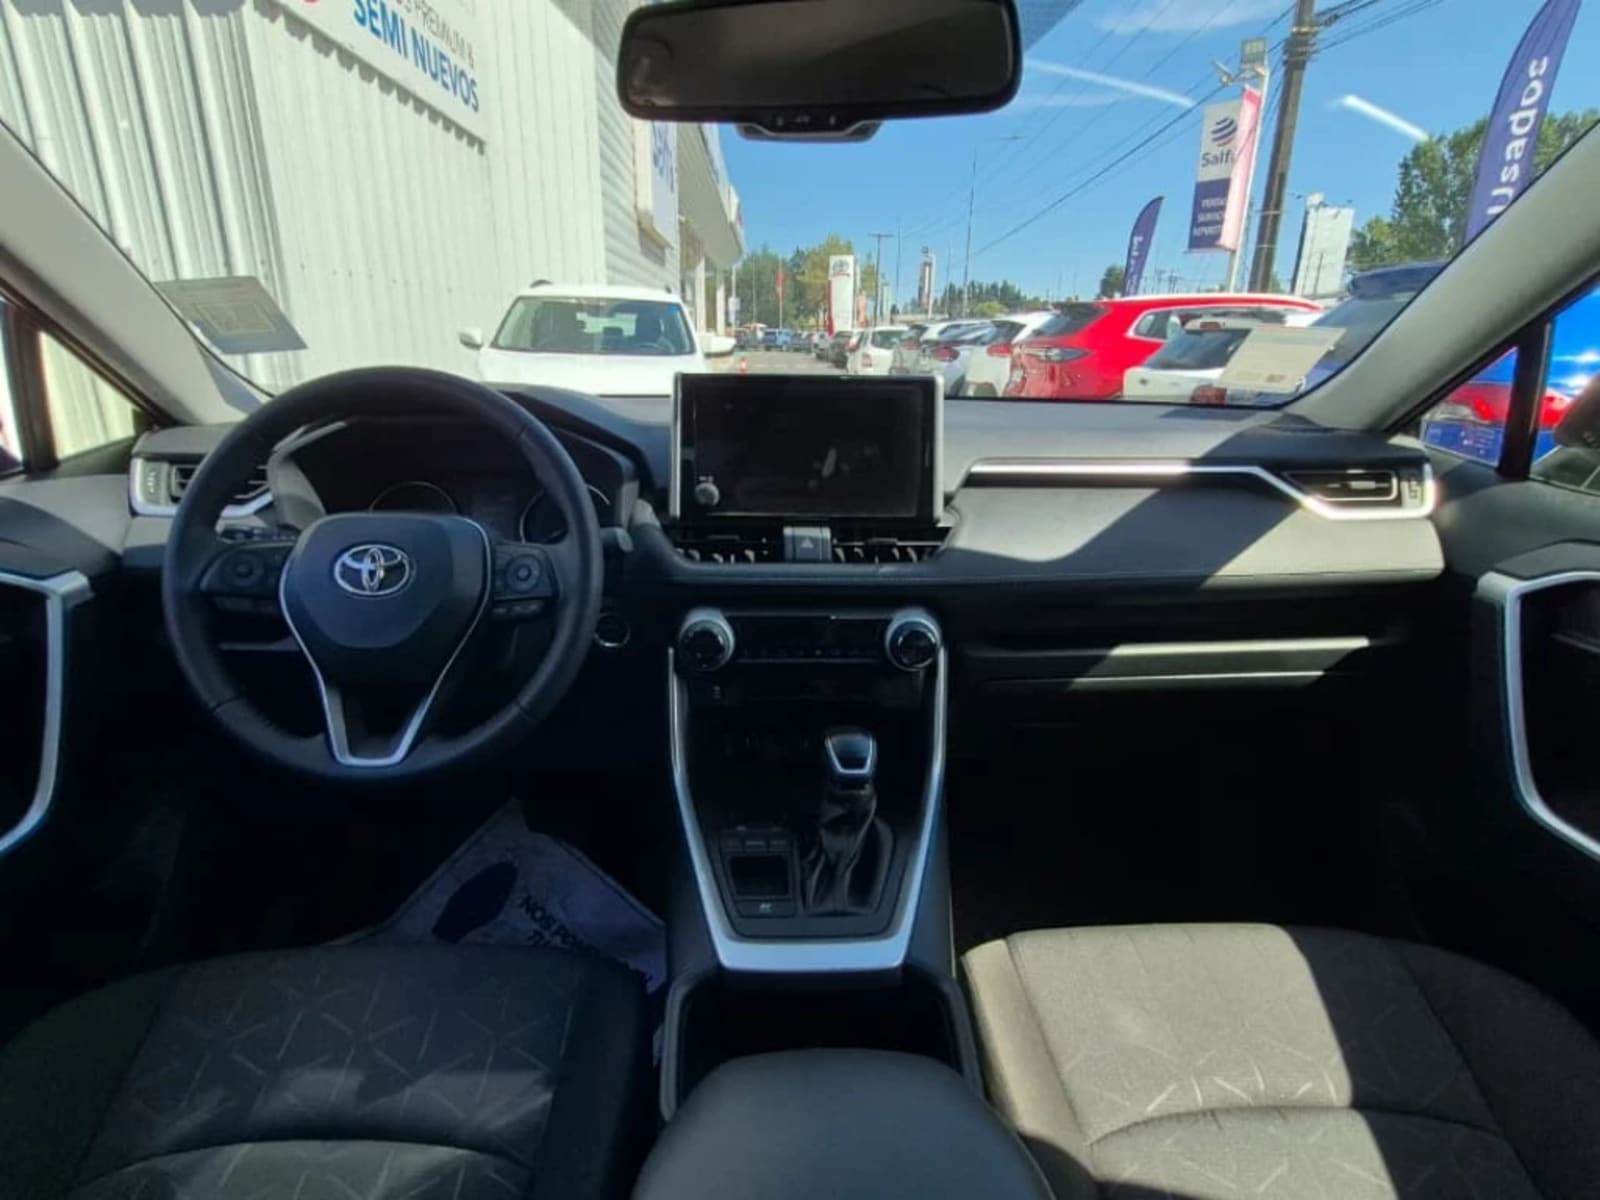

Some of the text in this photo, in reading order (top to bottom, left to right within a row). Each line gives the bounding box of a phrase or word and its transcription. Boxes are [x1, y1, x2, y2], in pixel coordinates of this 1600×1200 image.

[353, 0, 480, 113] SEMI NUEVOS
[1486, 55, 1549, 216] Usados
